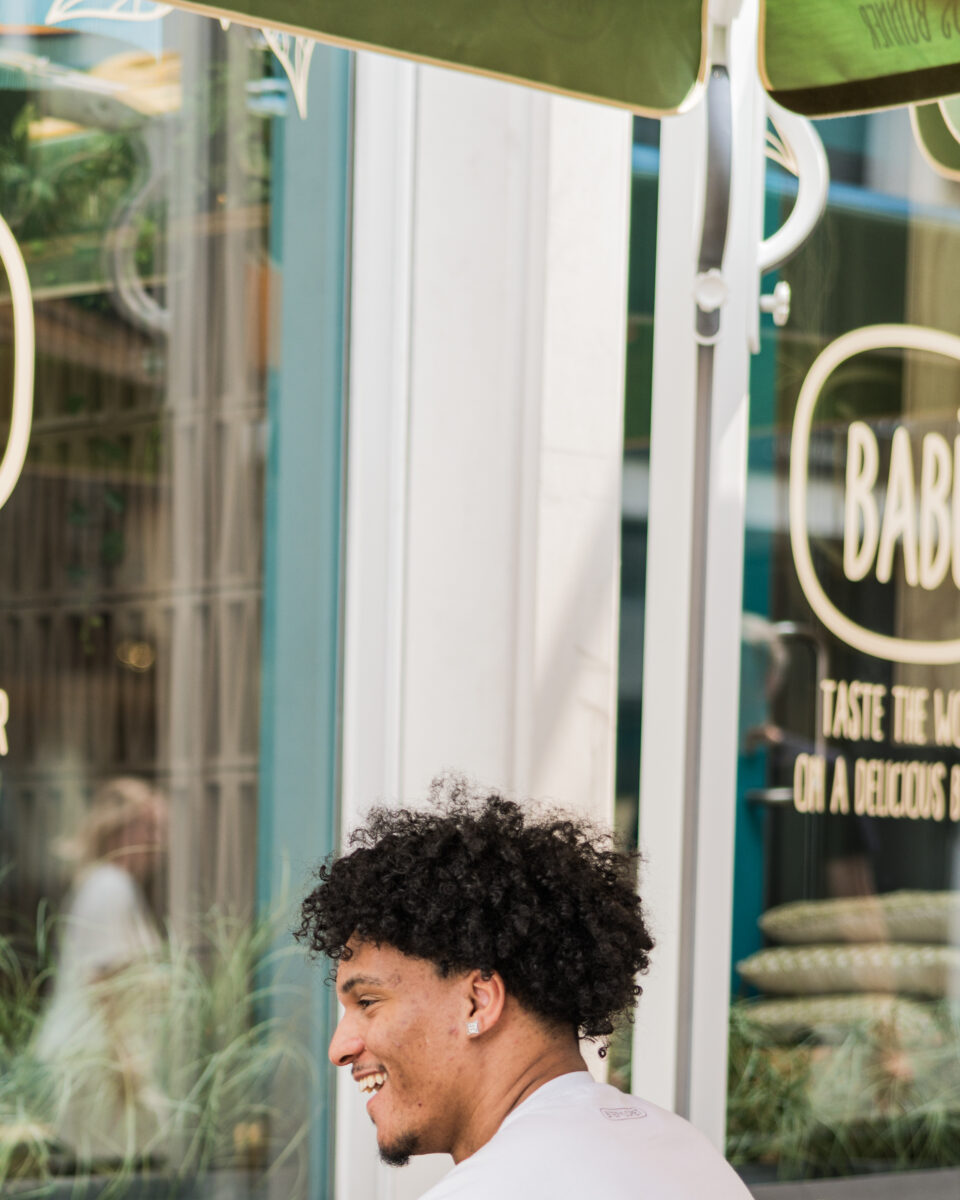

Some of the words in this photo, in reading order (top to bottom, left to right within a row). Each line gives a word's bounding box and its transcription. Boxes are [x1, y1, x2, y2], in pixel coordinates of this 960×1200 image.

[820, 679, 886, 742] TASTE
[892, 685, 929, 745] THE
[794, 753, 826, 814] ON
[829, 755, 850, 816] A
[854, 757, 947, 821] DELICIOUS
